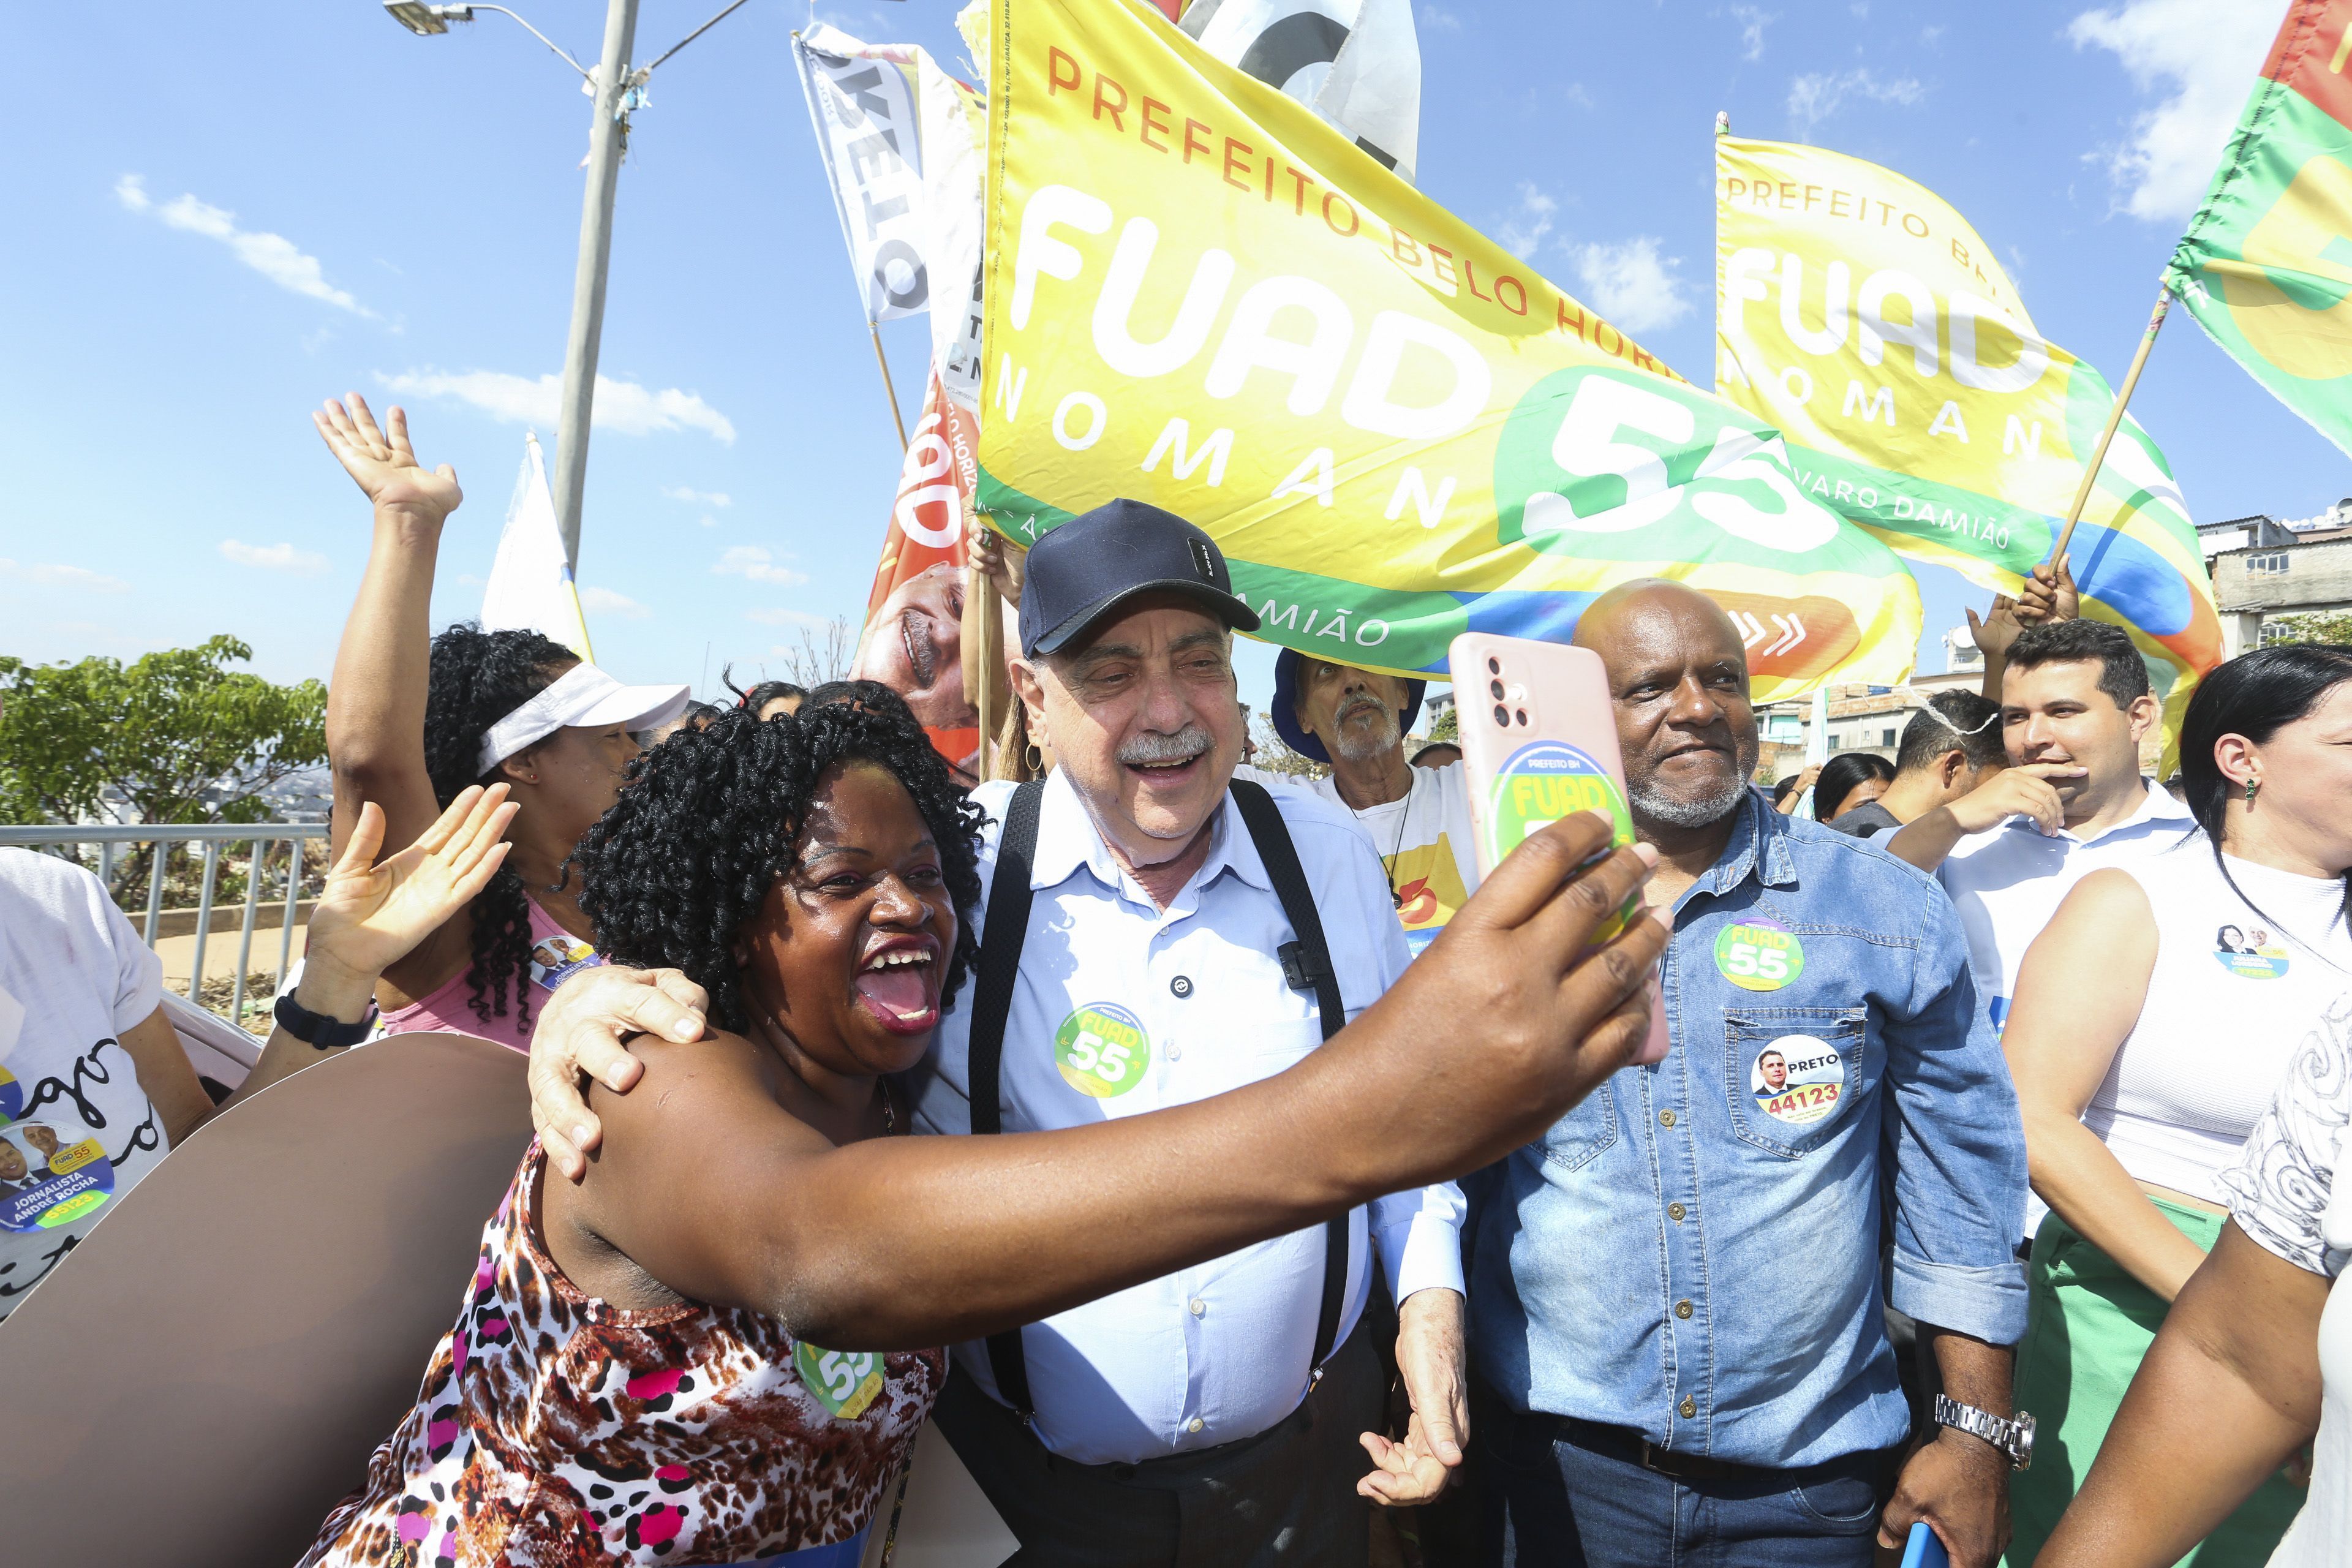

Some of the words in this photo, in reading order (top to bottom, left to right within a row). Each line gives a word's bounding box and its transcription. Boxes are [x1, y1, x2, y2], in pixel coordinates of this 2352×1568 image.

[1048, 45, 1360, 237] PREFEITO
[1388, 225, 1528, 316] BELO
[1727, 178, 1929, 238] PREFEITO
[1009, 184, 1492, 440] FUAD
[1723, 247, 2049, 394] FUAD
[1723, 348, 2042, 461] NOMAN
[995, 352, 1457, 529] NOMAN
[1521, 374, 1839, 552] 55
[1793, 467, 1878, 508] VARO
[1893, 495, 2009, 549] DAMIÃO
[1528, 759, 1567, 769] PREFEITO
[1568, 760, 1581, 769] BH
[1513, 776, 1607, 816] FUAD
[1732, 927, 1790, 949] FUAD
[1745, 922, 1769, 931] PREFEITO
[555, 960, 587, 982] JORNALISTA
[1727, 943, 1789, 979] 55
[1080, 1011, 1139, 1047] FUAD
[1099, 1008, 1122, 1020] PREFEITO
[1123, 1016, 1131, 1024] BH
[1067, 1031, 1131, 1082] 55
[1788, 1054, 1839, 1074] PRETO
[1769, 1084, 1838, 1115] 44123
[74, 1146, 91, 1159] 55
[14, 1195, 56, 1223] ANDRÉ
[56, 1176, 98, 1200] ROCHA
[15, 1172, 84, 1210] JORNALISTA
[45, 1194, 94, 1219] 55123
